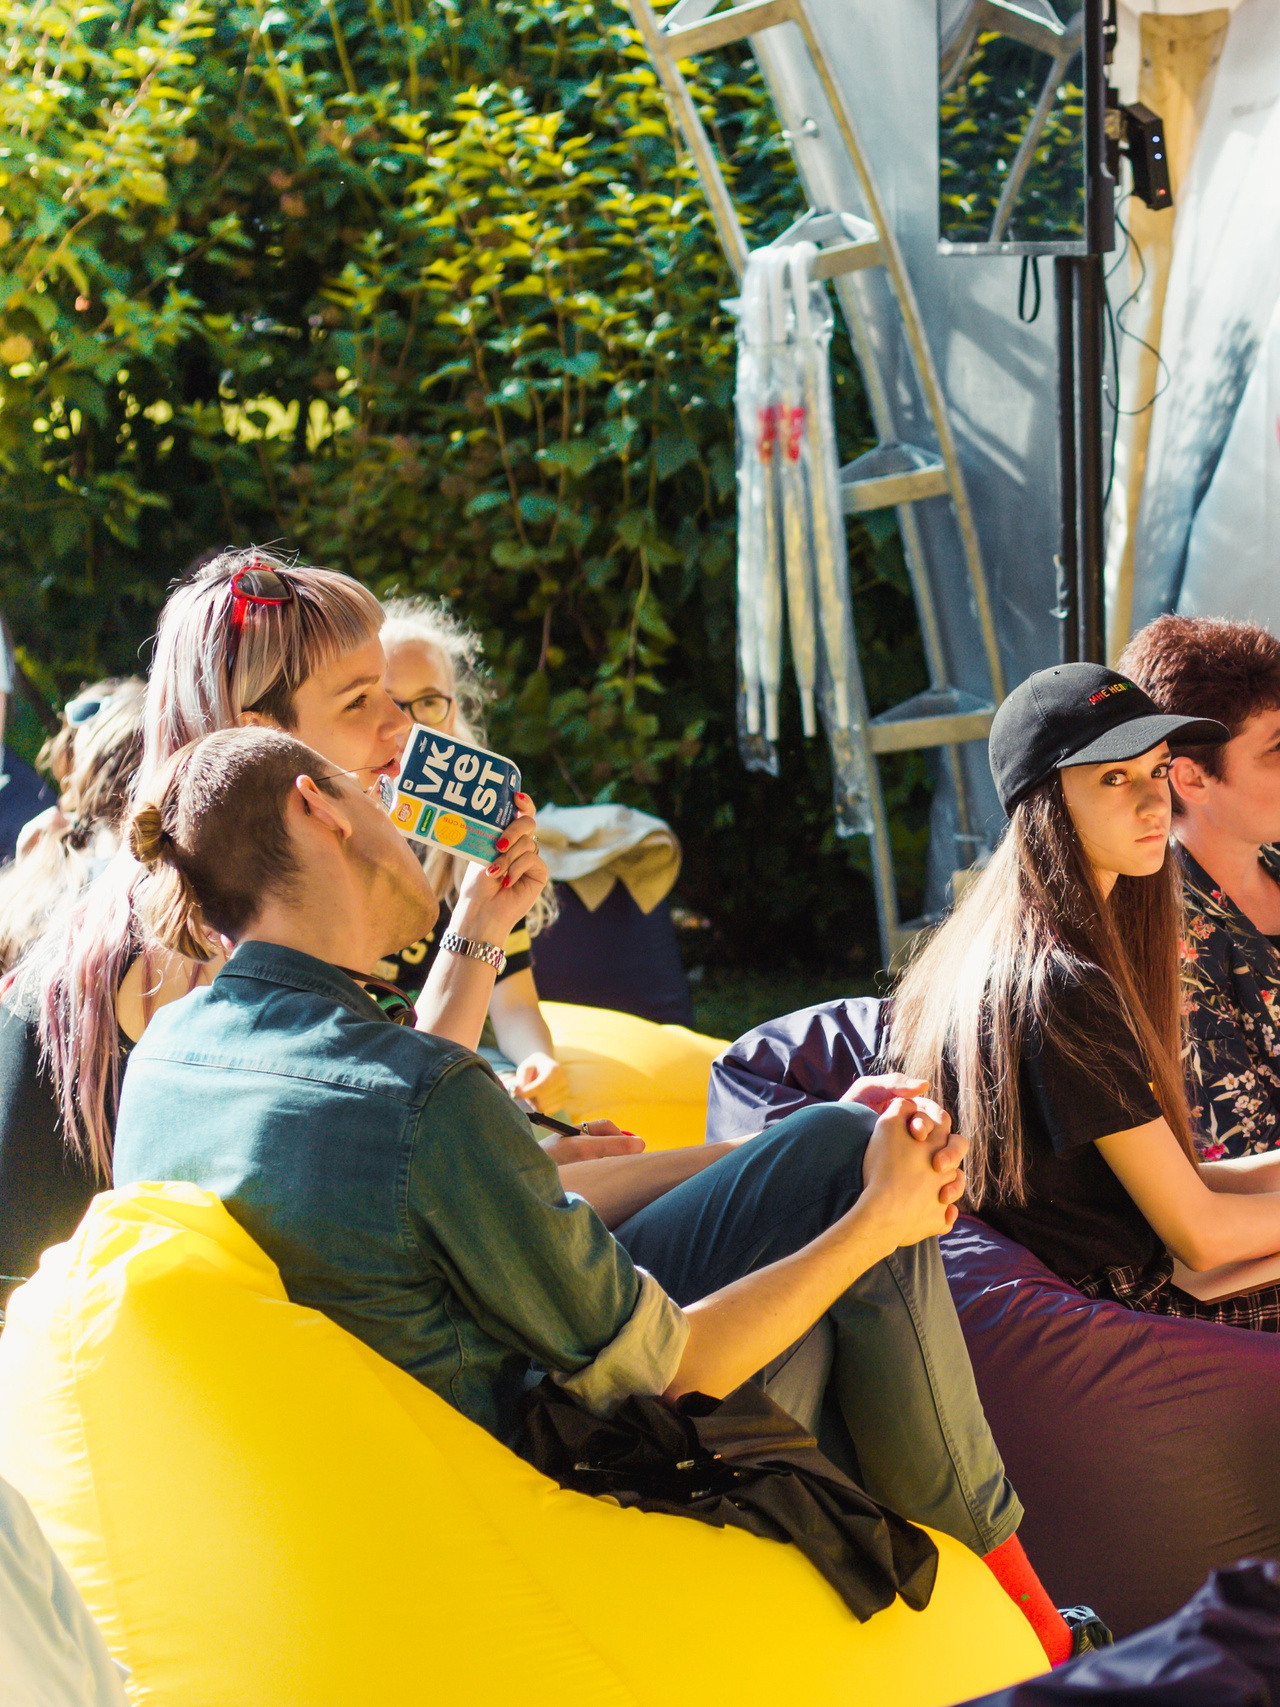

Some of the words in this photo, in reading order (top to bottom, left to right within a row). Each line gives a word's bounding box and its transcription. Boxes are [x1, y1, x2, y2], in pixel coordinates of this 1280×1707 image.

[1089, 689, 1110, 705] МНЕ
[415, 741, 455, 793] VK
[443, 753, 480, 807] Fe
[471, 760, 504, 816] ST
